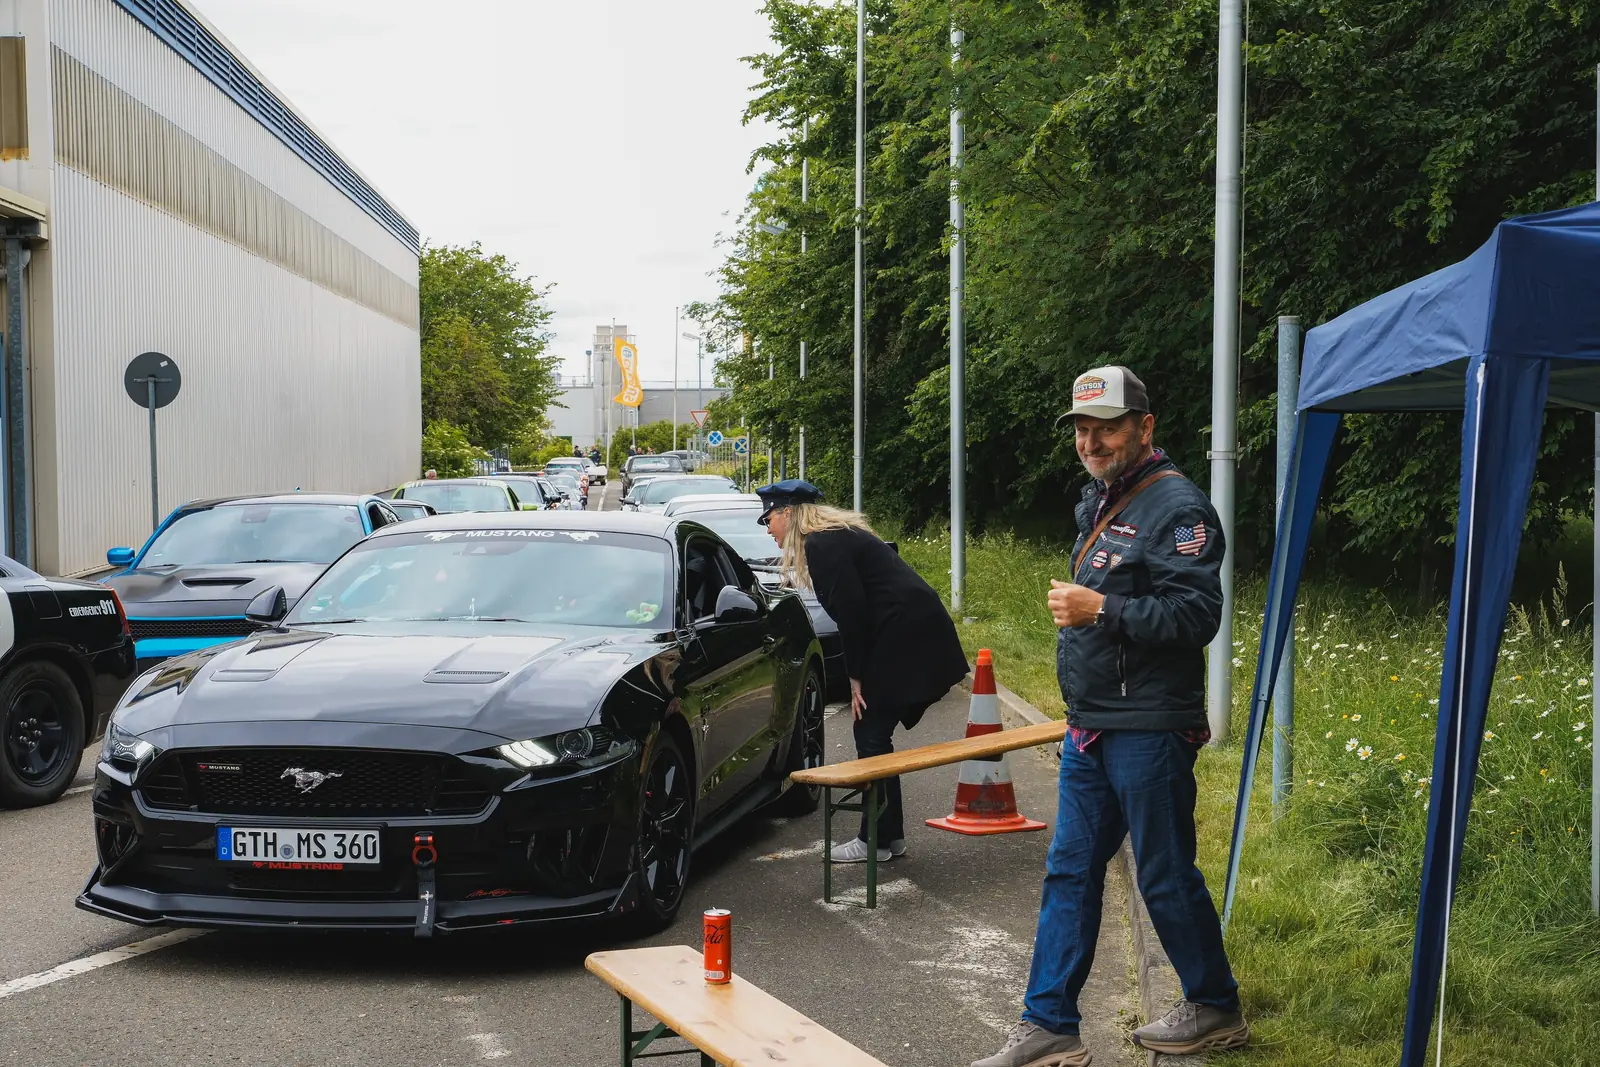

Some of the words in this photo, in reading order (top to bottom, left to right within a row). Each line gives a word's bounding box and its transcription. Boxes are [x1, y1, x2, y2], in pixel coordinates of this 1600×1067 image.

[466, 530, 555, 538] MUSTANG
[68, 605, 102, 617] EMERGENCY
[99, 599, 116, 614] 911
[221, 847, 228, 855] D
[233, 831, 277, 857] GTH
[297, 832, 326, 859] MS
[334, 833, 377, 860] 360
[269, 861, 343, 870] MUSTANG
